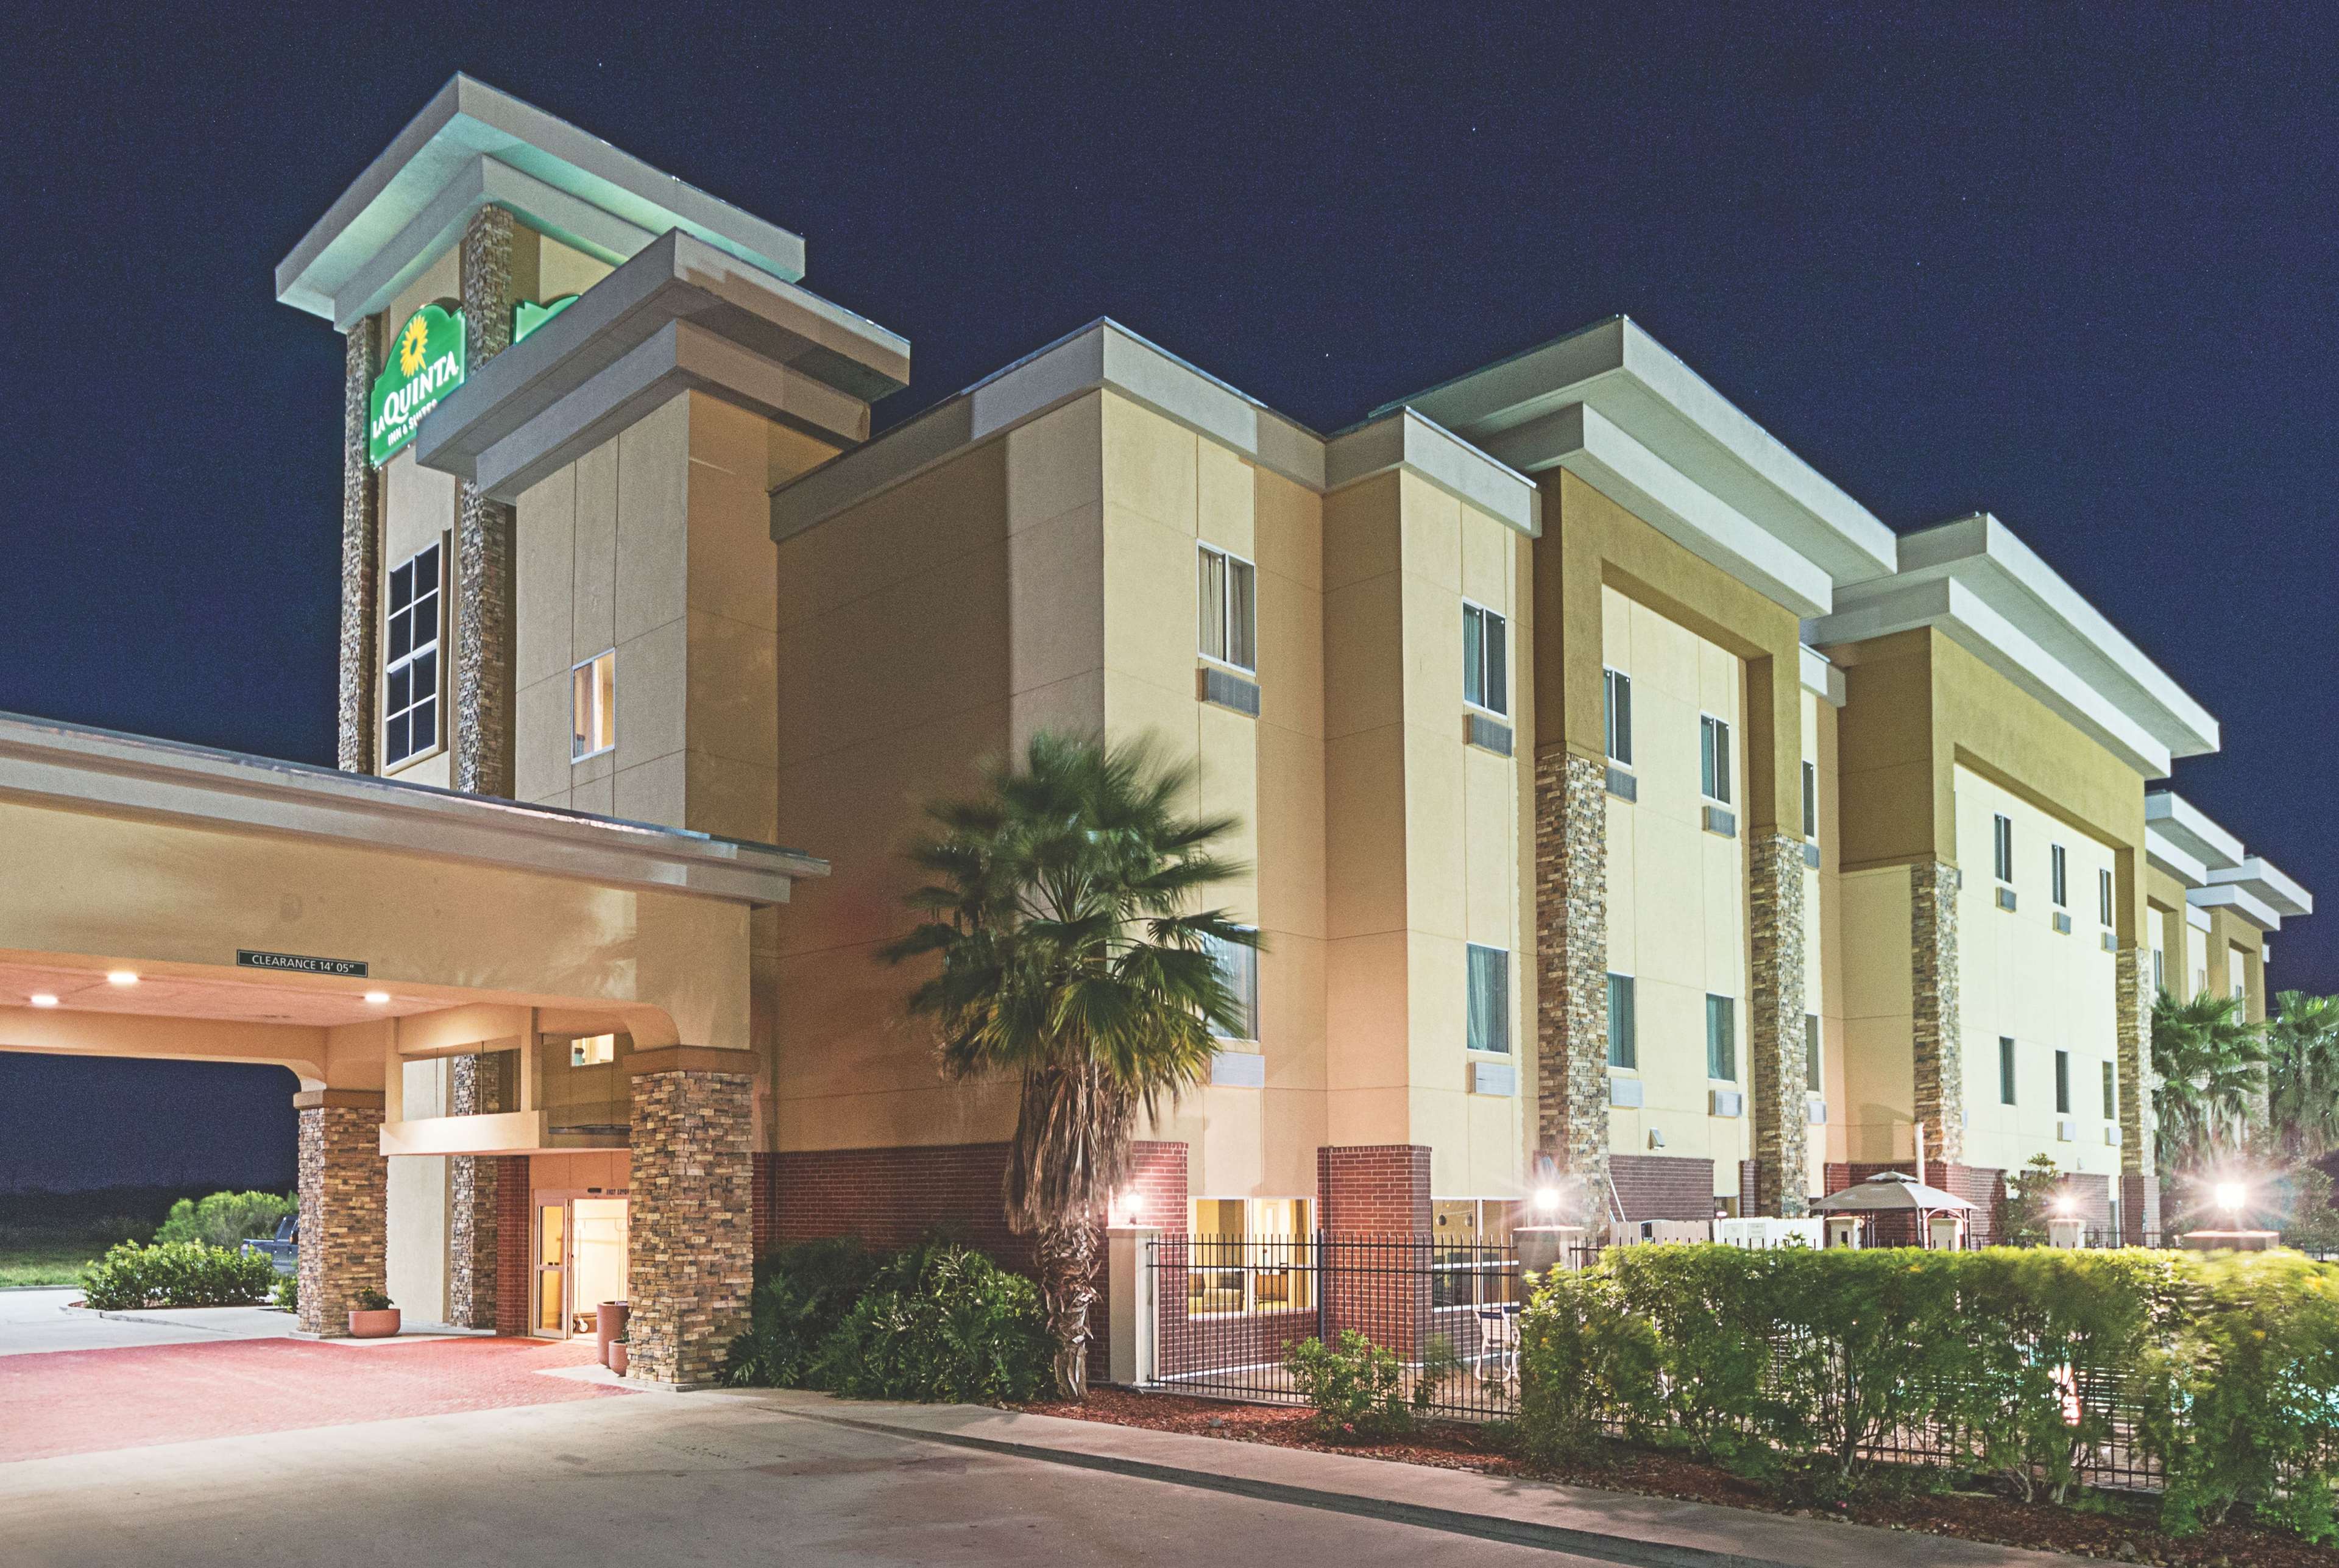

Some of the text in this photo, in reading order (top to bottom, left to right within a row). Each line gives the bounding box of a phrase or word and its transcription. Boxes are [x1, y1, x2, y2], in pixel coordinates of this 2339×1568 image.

[373, 351, 459, 438] LA QUINTA
[387, 426, 402, 447] INN
[402, 424, 408, 435] &
[252, 955, 316, 970] CLEARANCE
[319, 961, 333, 971] 14'
